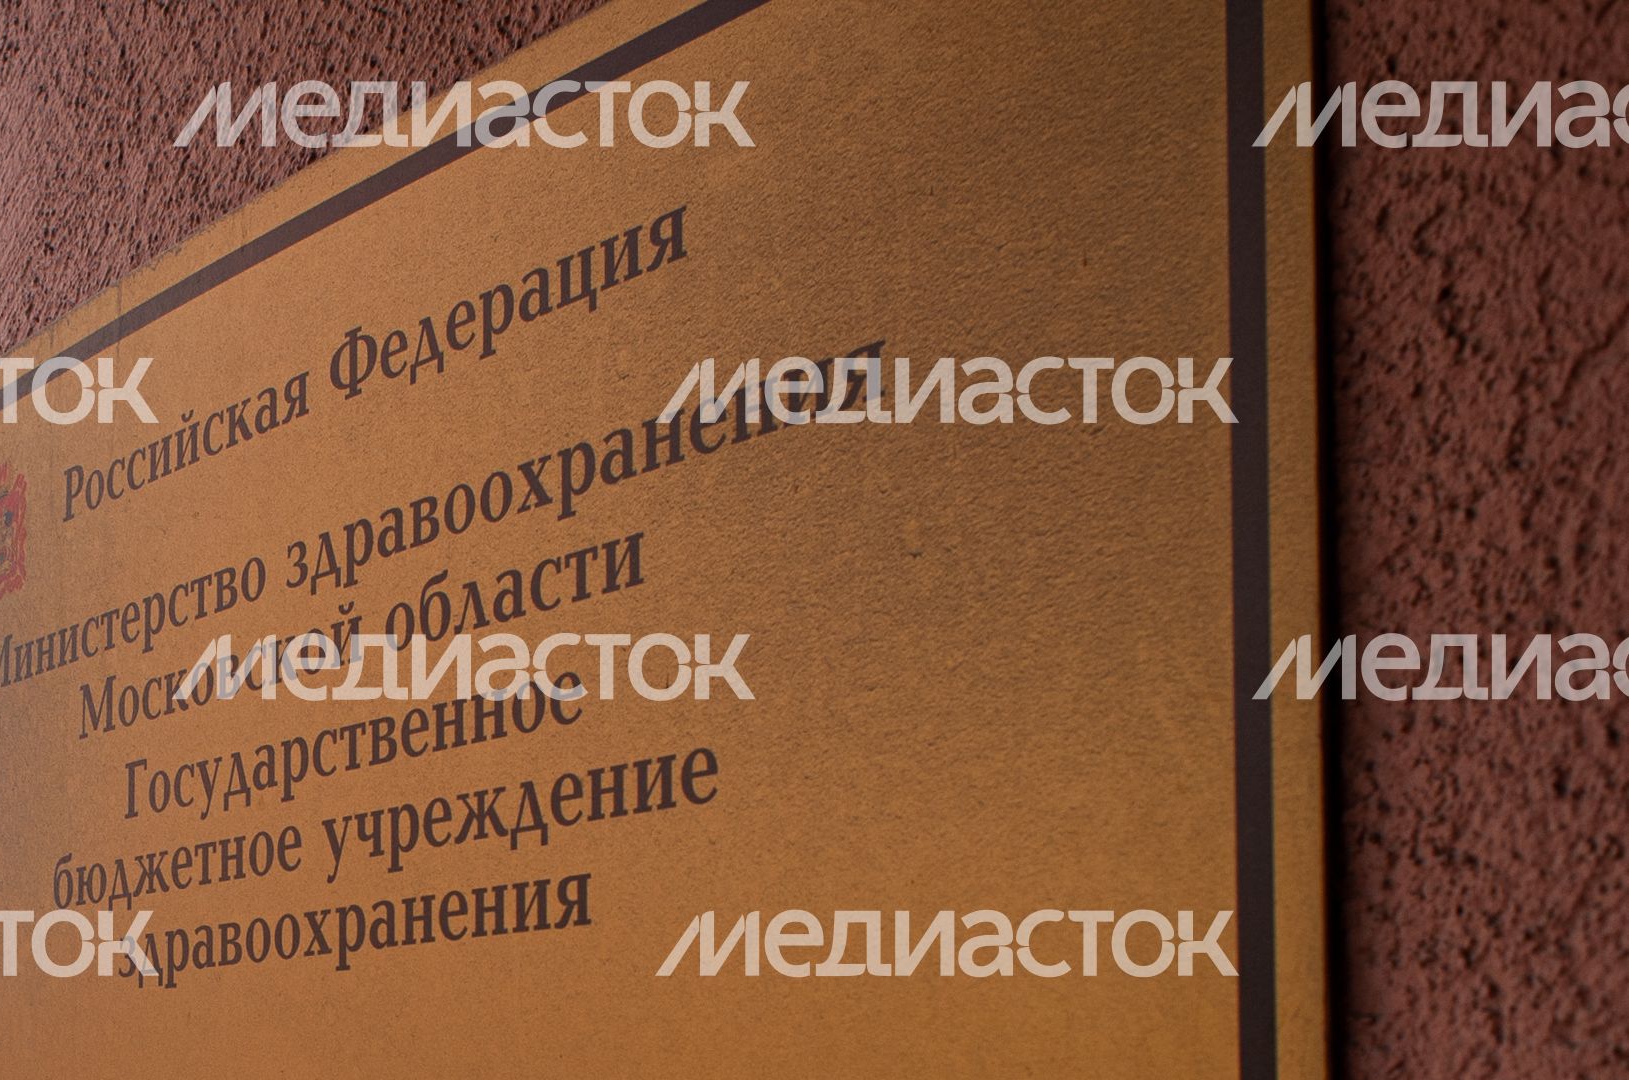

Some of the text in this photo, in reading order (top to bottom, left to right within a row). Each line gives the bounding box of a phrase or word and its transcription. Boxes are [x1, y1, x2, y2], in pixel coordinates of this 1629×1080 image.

[62, 206, 688, 523] Российская Федерация
[286, 338, 886, 595] здравоохранения
[79, 532, 645, 740] Московской области
[53, 746, 719, 911] бюджетное учреждение
[124, 671, 584, 819] Государственное
[117, 871, 593, 989] здравоохранения
